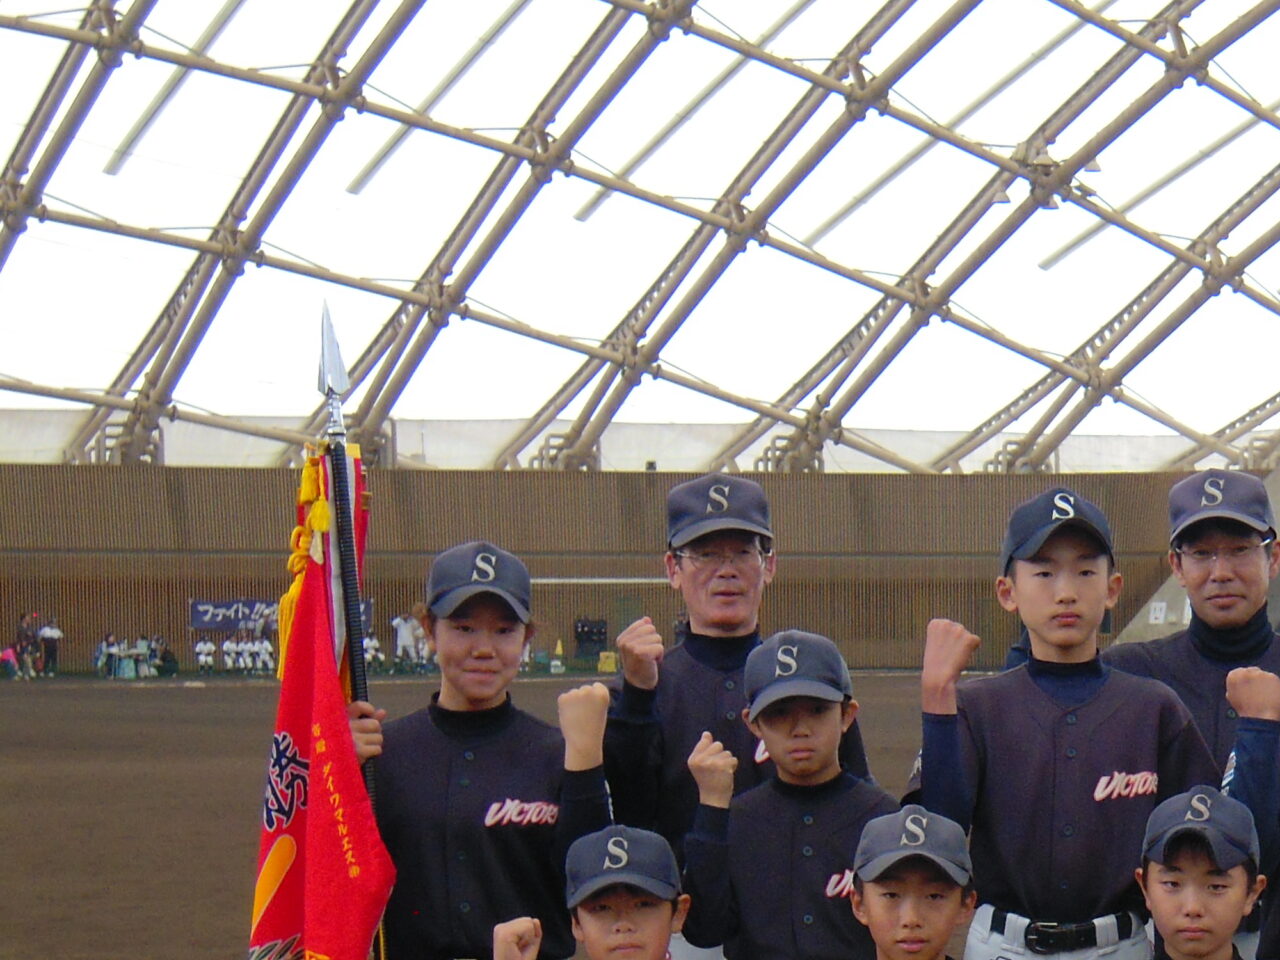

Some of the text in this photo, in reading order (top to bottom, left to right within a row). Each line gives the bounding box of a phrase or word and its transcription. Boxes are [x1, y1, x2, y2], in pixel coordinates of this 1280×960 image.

[706, 485, 729, 513] S
[1052, 493, 1075, 520] S
[1201, 478, 1224, 507] S
[471, 552, 497, 582] S
[775, 645, 798, 678] S
[1184, 794, 1211, 821] S
[900, 815, 927, 845] S
[603, 837, 628, 869] S
